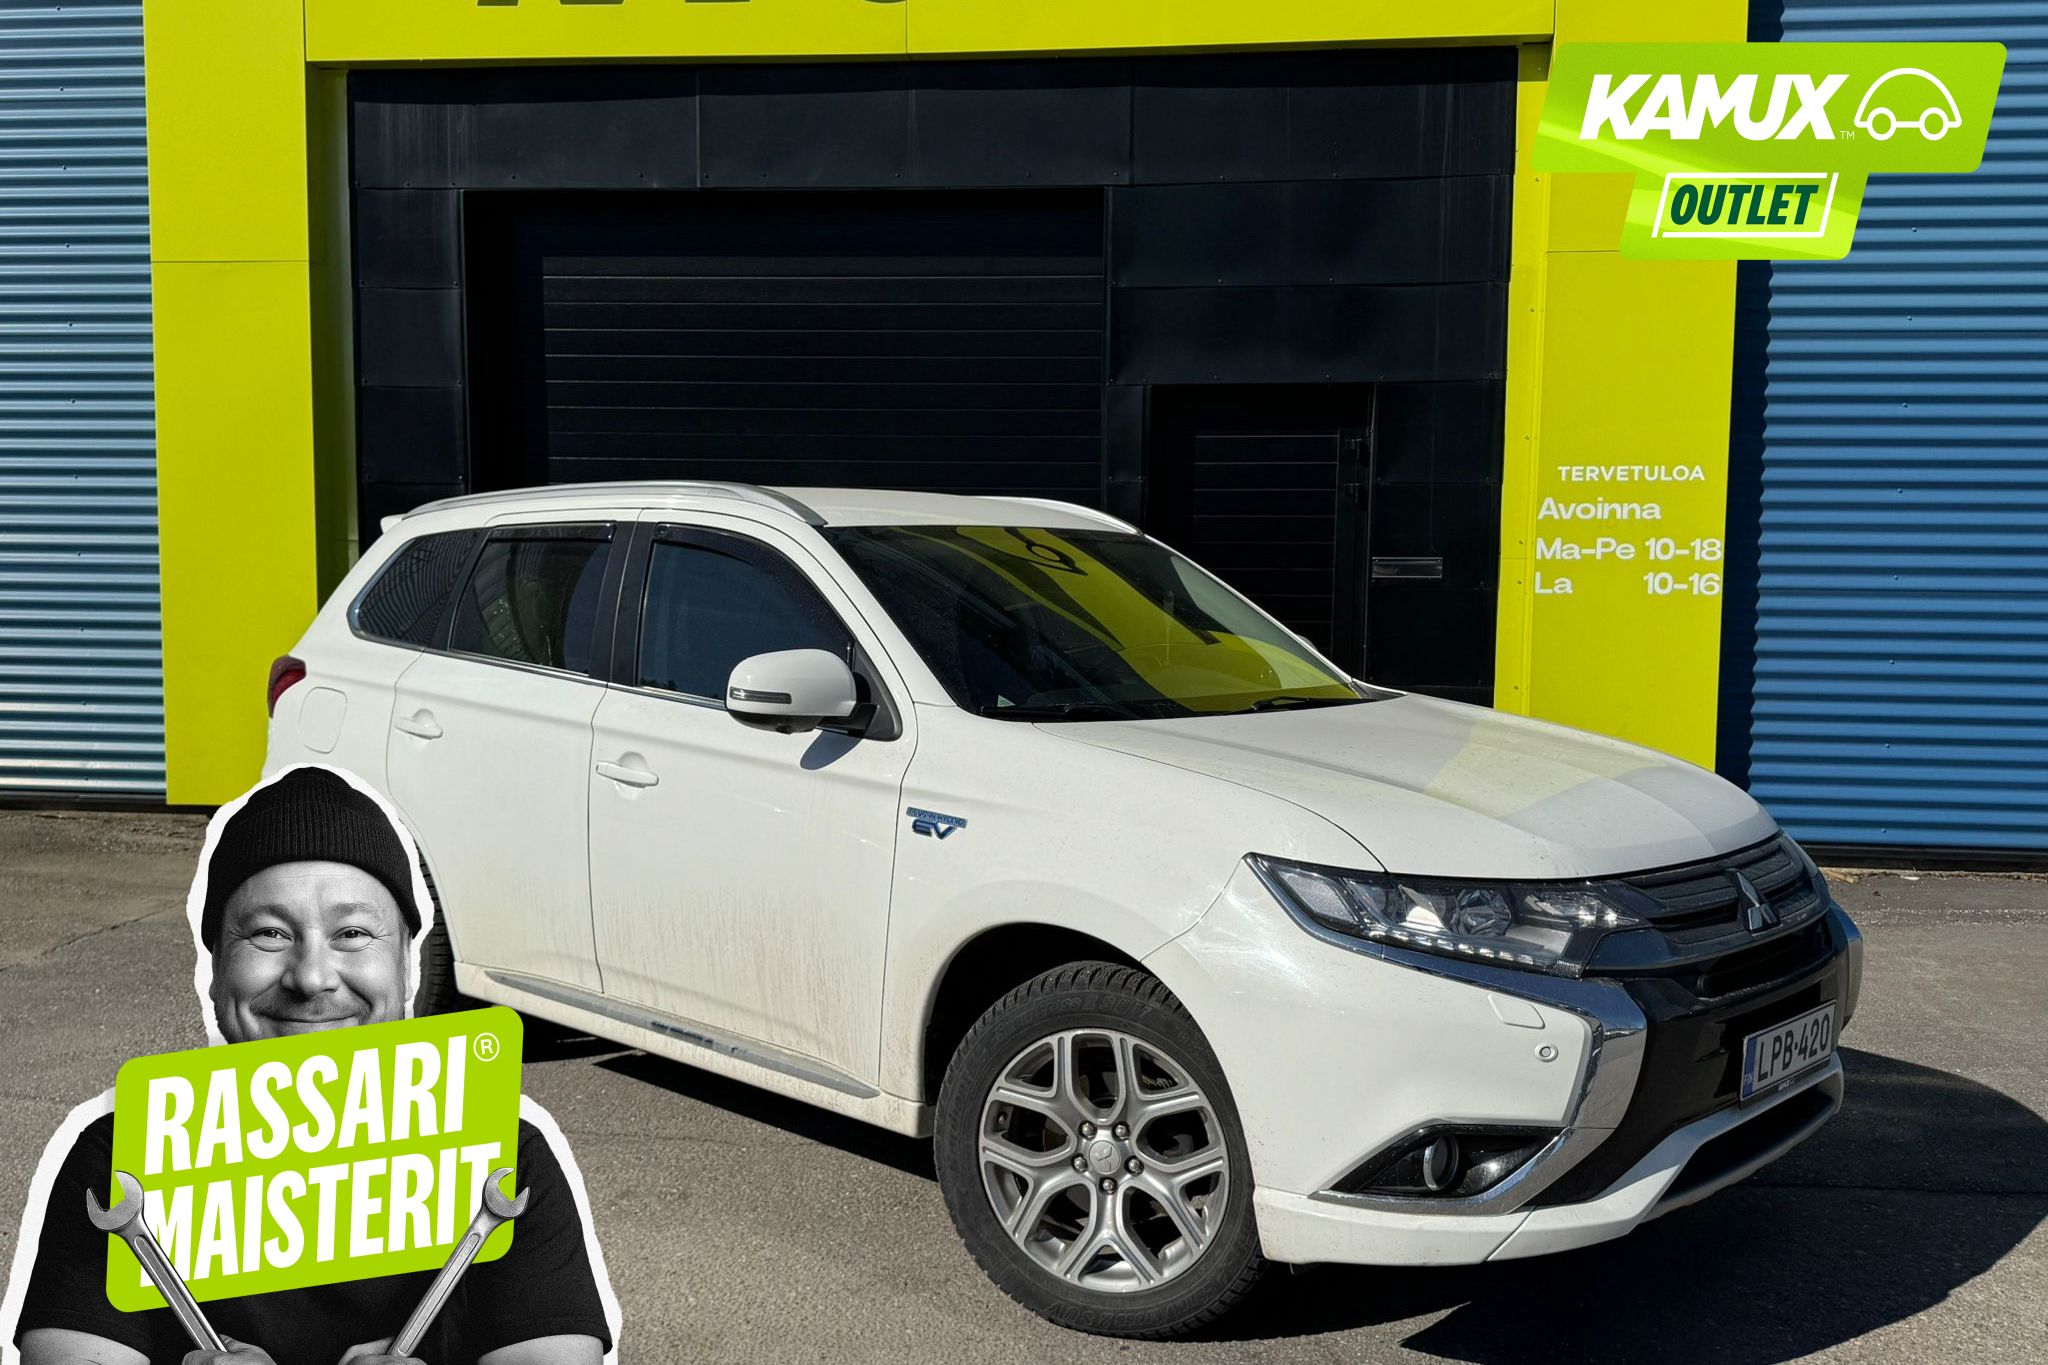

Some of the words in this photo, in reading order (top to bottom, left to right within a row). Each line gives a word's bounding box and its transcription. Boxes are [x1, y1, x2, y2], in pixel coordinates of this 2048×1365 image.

[1557, 465, 1706, 482] TERVETULOA
[1537, 497, 1662, 520] Avoinna
[1536, 537, 1636, 560] Ma-Pe
[1644, 538, 1723, 561] 10-18
[1534, 571, 1574, 594] La
[1643, 572, 1722, 595] 10-16
[1757, 1013, 1831, 1082] LPB-420
